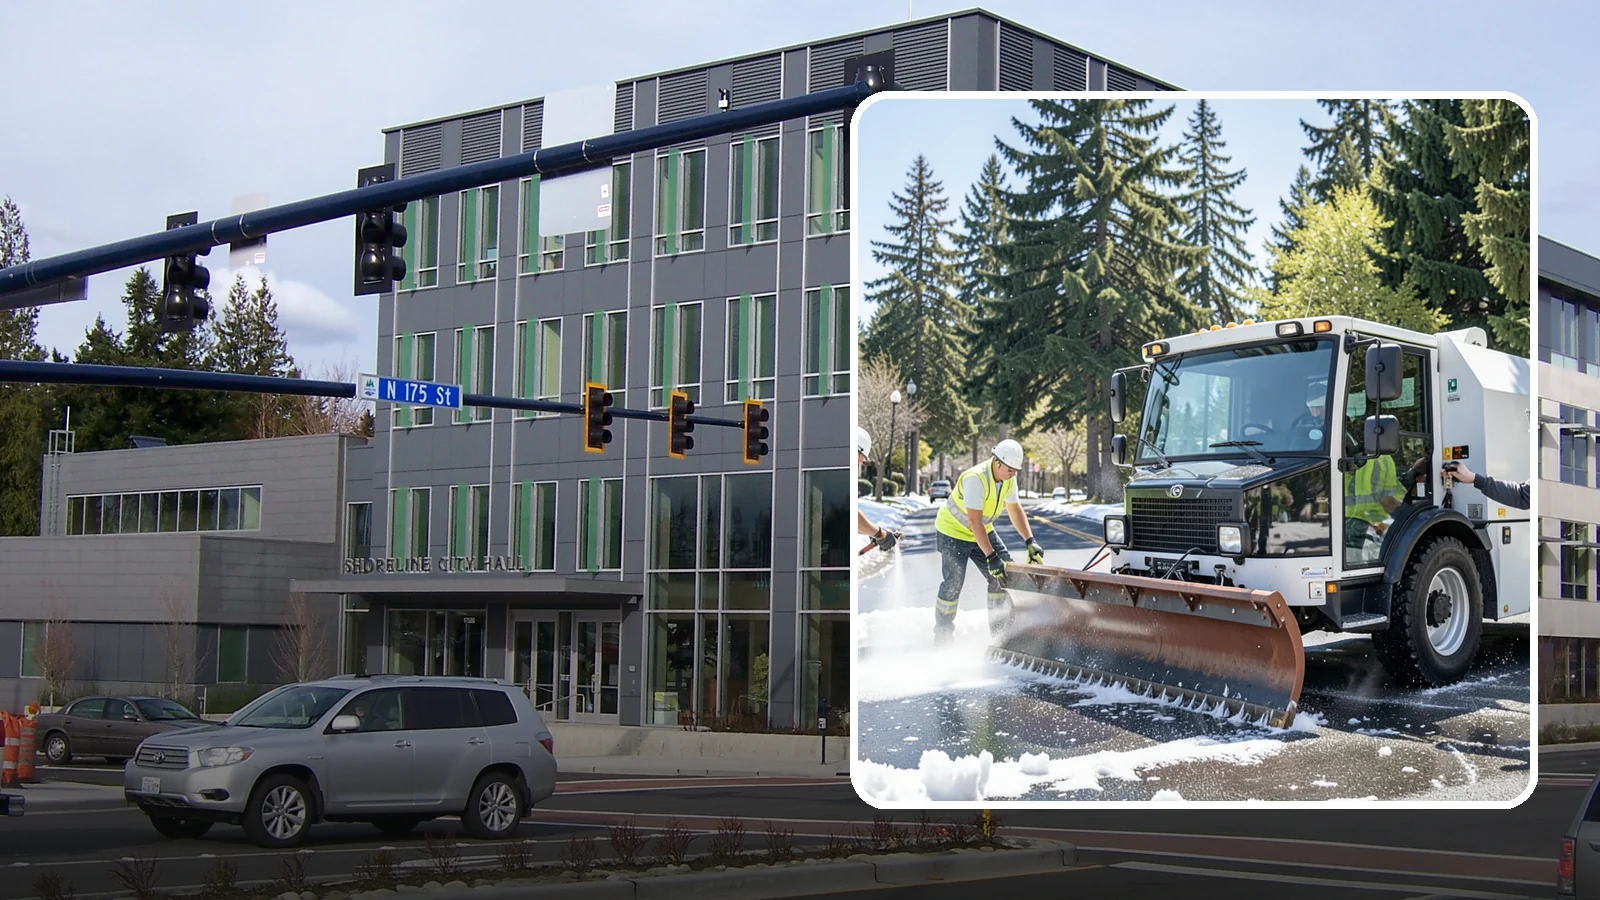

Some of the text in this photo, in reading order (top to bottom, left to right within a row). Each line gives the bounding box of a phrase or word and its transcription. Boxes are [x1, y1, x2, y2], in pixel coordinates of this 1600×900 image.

[387, 380, 451, 406] N 175 St
[344, 554, 526, 573] SHORELINE CITY HALL
